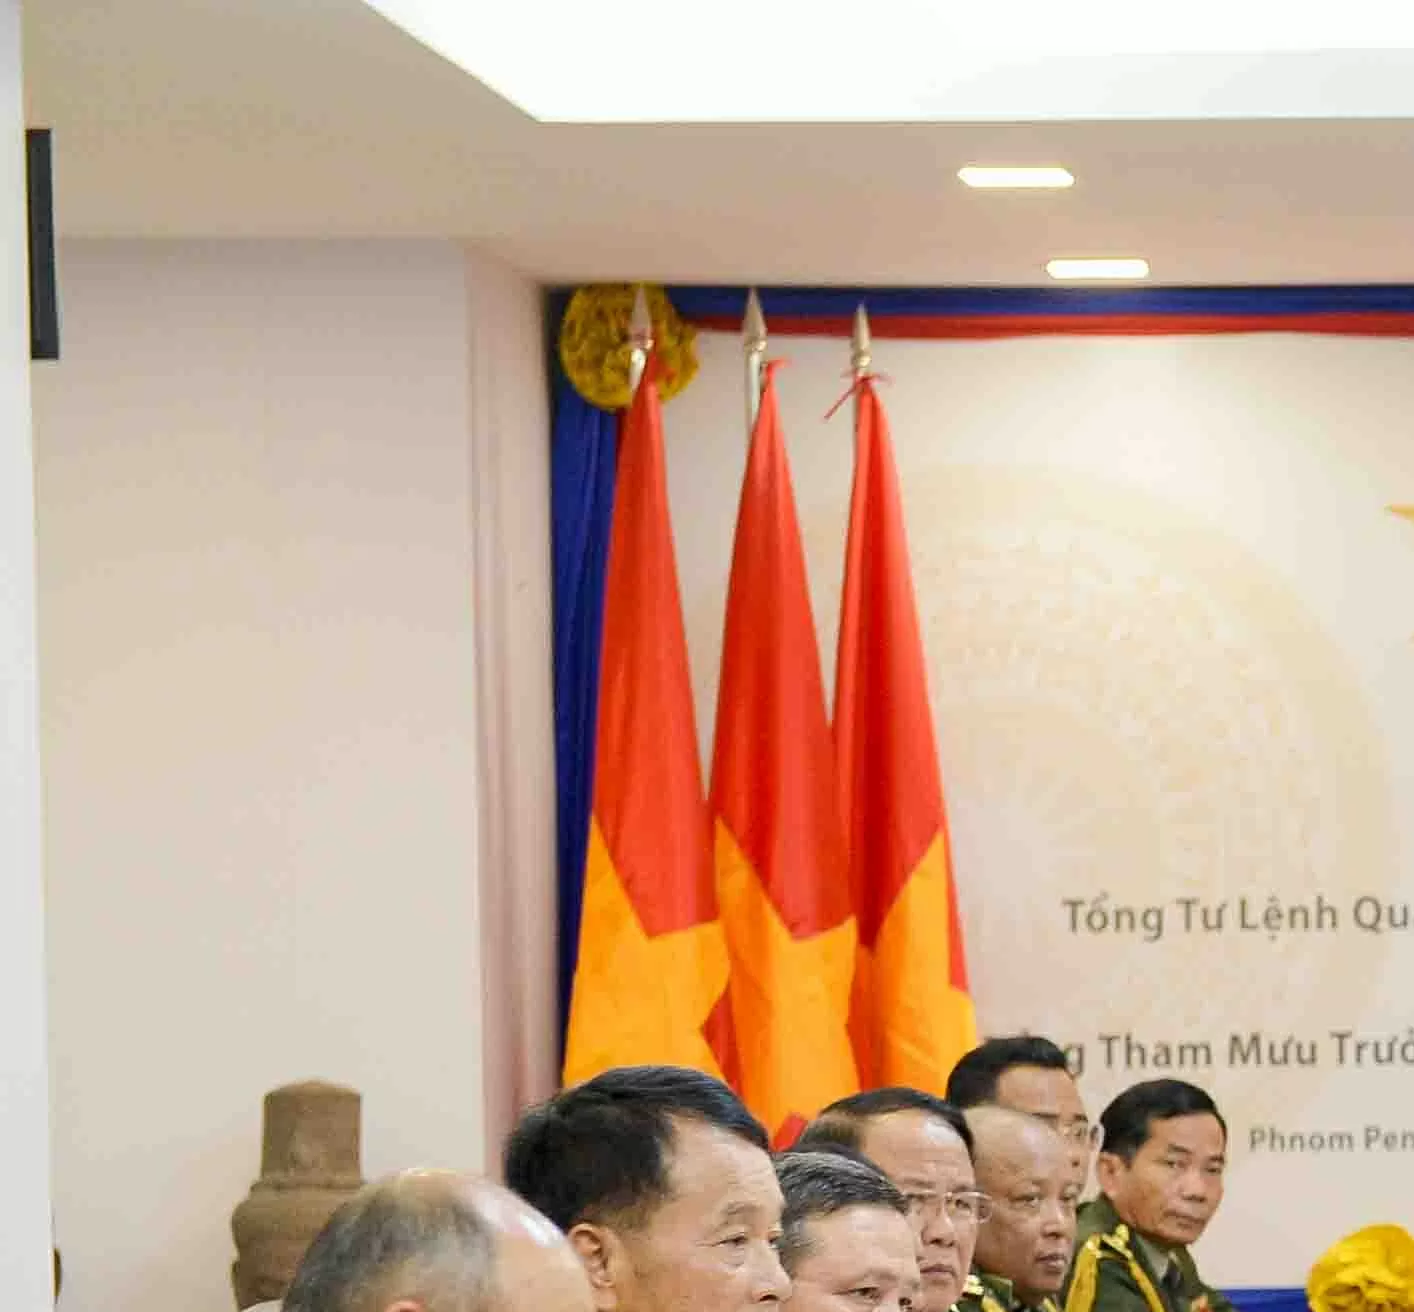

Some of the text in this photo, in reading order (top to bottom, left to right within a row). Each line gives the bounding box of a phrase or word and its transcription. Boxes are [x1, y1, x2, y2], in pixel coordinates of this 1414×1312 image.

[1061, 890, 1165, 943] Tổng
[1175, 896, 1228, 933] Tư
[1239, 894, 1339, 941] Lệnh
[1098, 1032, 1213, 1068] Tham
[1228, 1031, 1319, 1067] Mưu
[1249, 1126, 1356, 1153] Phnom
